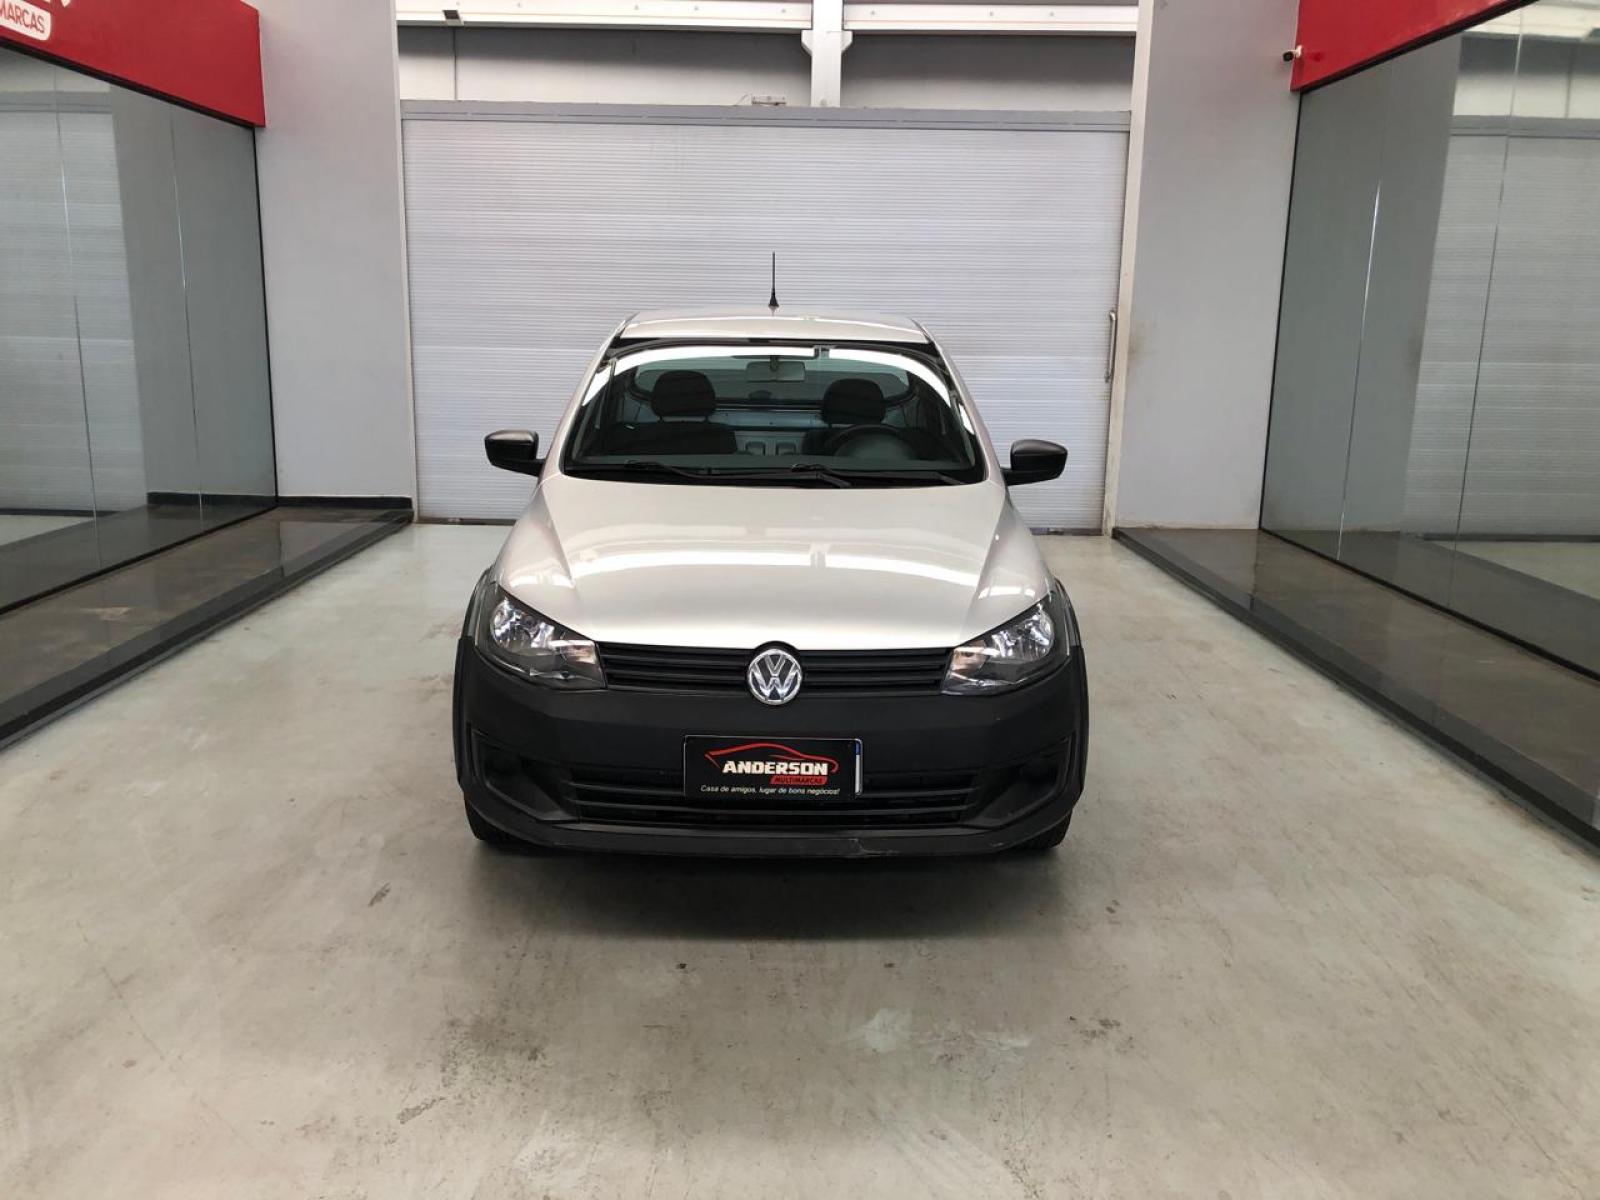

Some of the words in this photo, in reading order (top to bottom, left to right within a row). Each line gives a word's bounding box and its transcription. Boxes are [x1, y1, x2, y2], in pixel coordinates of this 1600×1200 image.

[722, 760, 828, 775] ANDERSON
[700, 784, 719, 792] Casa
[730, 786, 757, 794] amigos,
[759, 786, 777, 794] lugar
